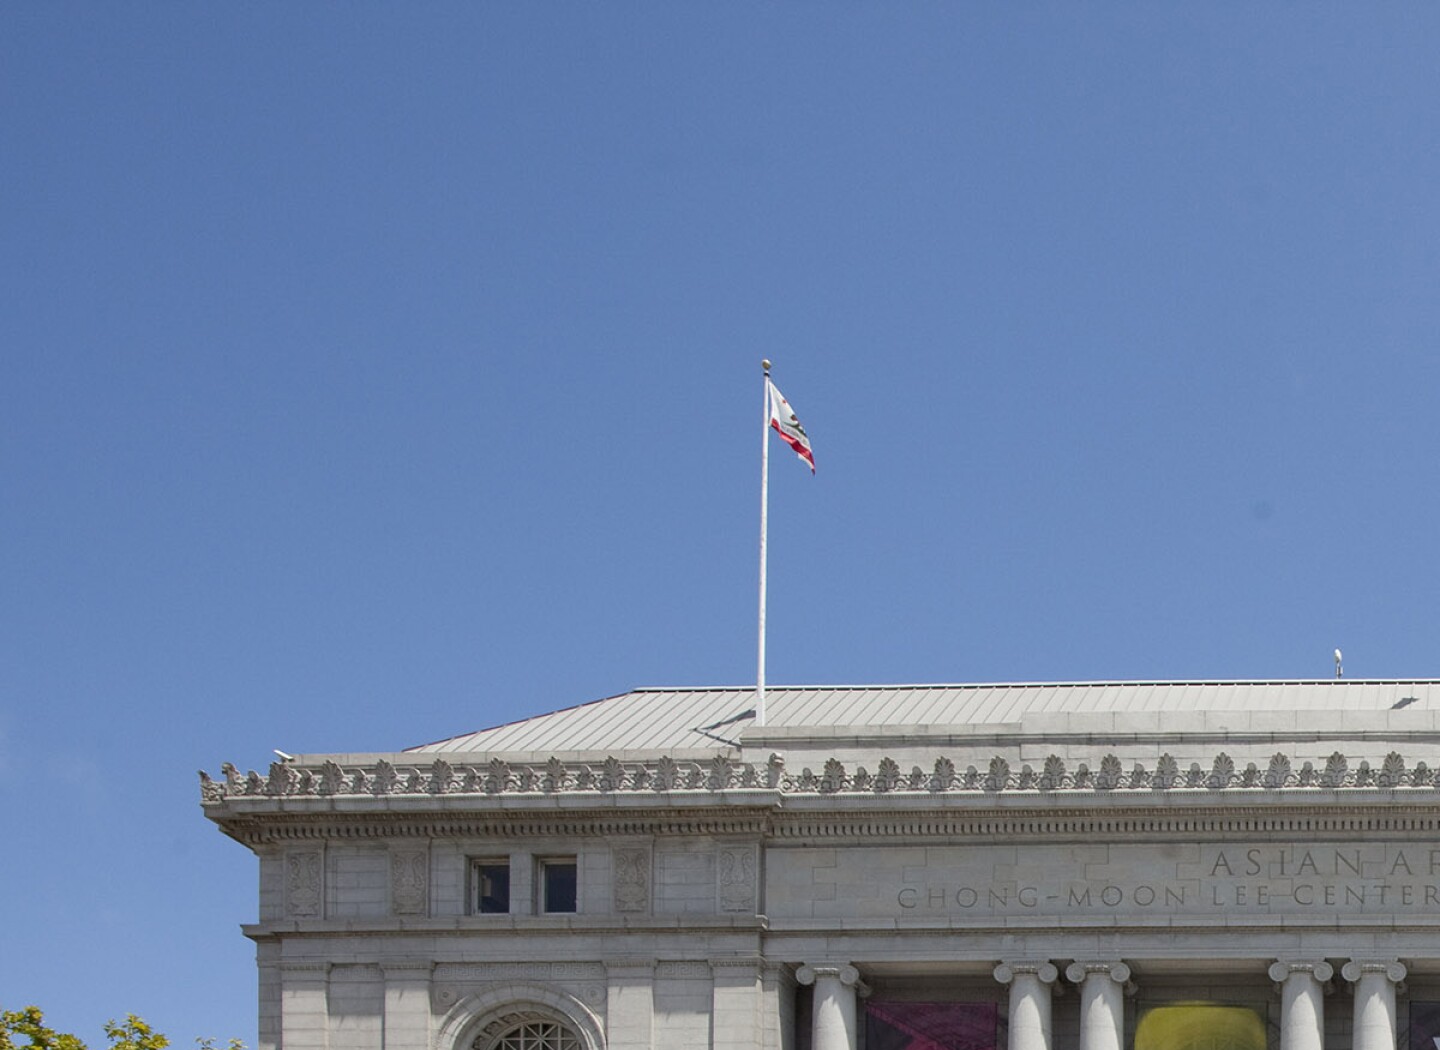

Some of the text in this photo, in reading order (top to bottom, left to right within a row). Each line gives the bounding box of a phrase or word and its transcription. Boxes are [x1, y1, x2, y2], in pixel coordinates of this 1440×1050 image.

[1209, 848, 1363, 877] ASIAN
[897, 885, 1187, 909] CHONG-MOON
[1212, 885, 1269, 906] LEE
